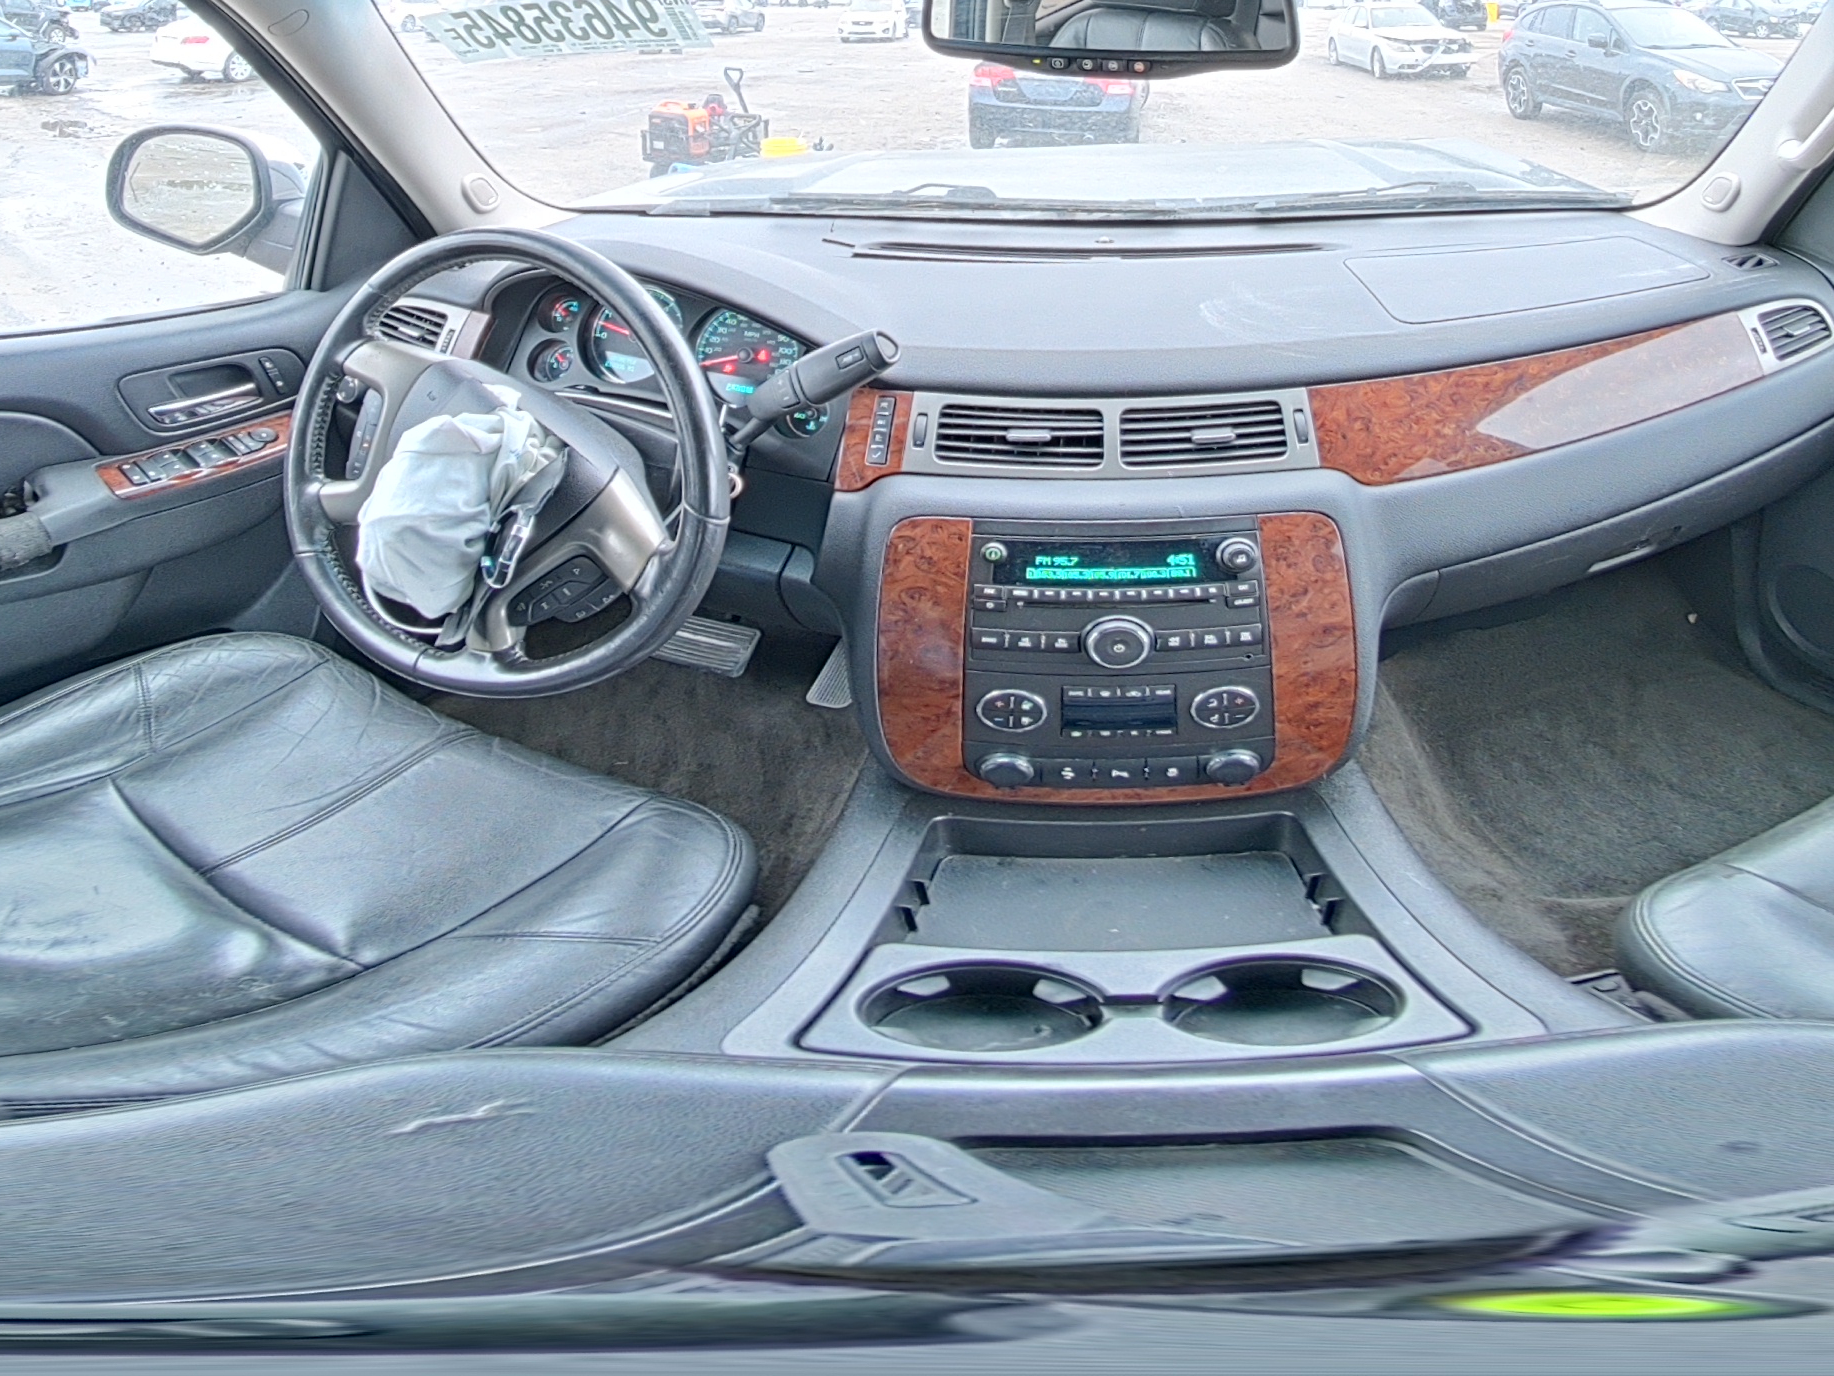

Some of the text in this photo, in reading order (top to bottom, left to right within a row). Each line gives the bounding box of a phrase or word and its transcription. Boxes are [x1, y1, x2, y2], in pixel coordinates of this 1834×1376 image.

[1035, 556, 1079, 566] FM 95.7
[1166, 554, 1196, 566] 4:51
